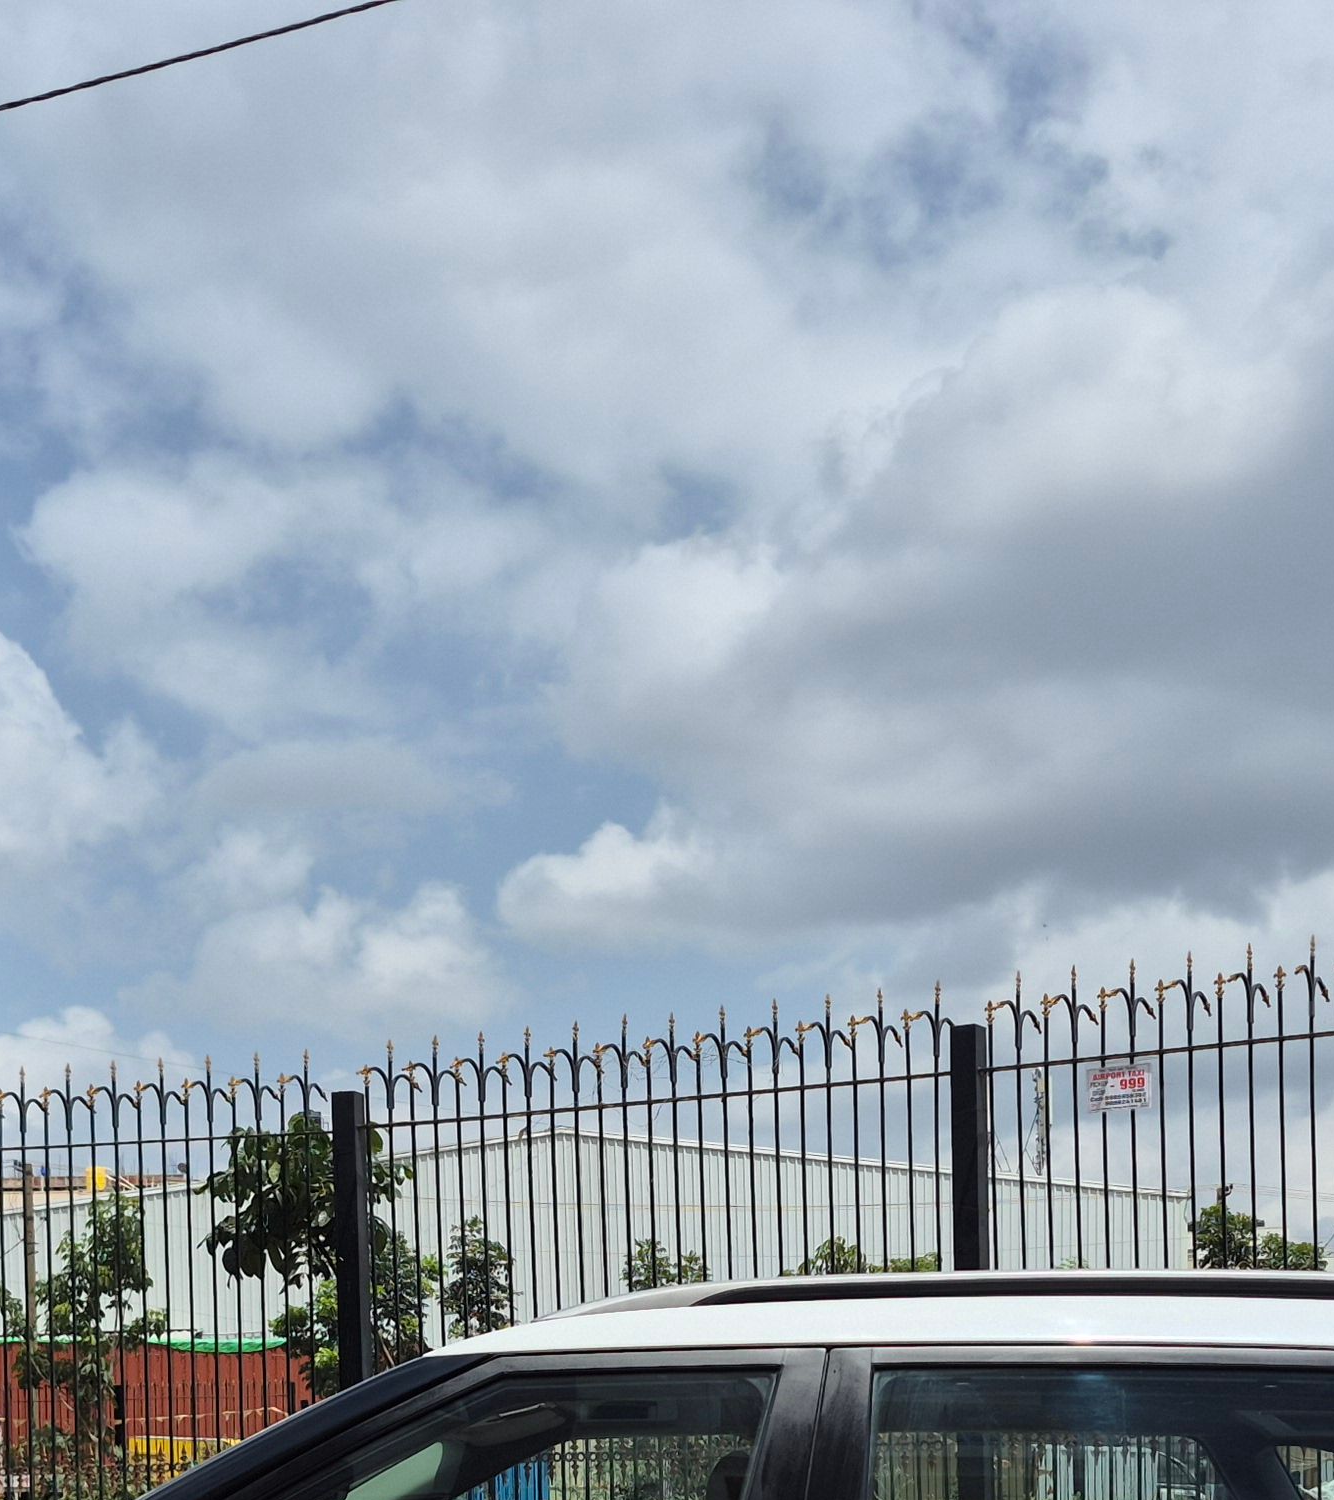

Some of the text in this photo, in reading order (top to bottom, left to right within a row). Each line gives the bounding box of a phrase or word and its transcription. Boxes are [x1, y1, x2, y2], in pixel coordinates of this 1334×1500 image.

[1092, 1069, 1145, 1081] AIRPORT TAXI
[1120, 1077, 1145, 1090] 999
